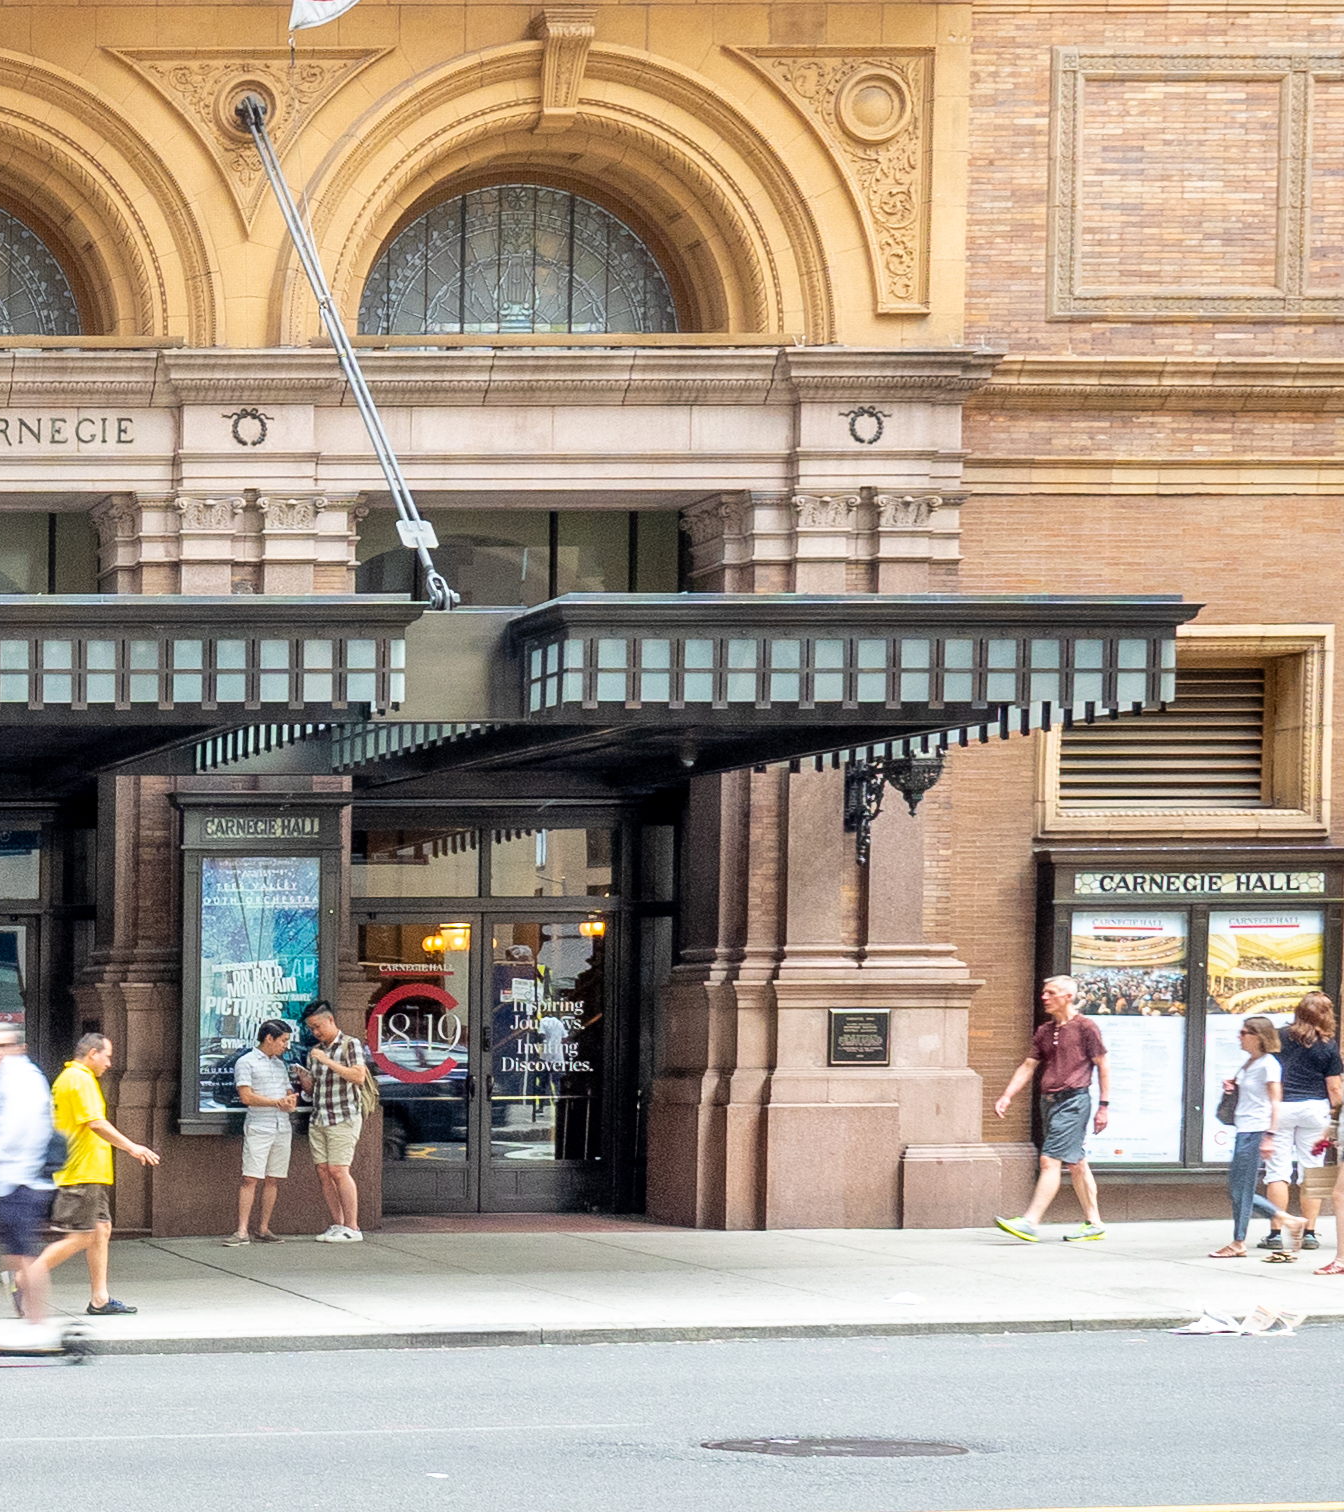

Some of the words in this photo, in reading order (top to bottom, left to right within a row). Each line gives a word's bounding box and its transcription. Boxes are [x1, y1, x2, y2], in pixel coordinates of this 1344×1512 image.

[204, 817, 279, 836] CARNEGIE
[282, 817, 320, 836] HALL
[1099, 875, 1222, 892] CARNEGIE
[1236, 875, 1301, 892] HALL
[245, 895, 318, 904] ORCHESTRA
[1092, 918, 1139, 926] CARNEGIE
[1140, 918, 1164, 927] HALL
[1228, 917, 1275, 925] CARNEGIE
[1276, 917, 1301, 925] HALL
[232, 970, 250, 984] ON
[252, 965, 283, 982] BALD
[379, 963, 427, 972] CARNEGIE
[428, 963, 454, 972] HALL
[227, 976, 297, 998] MOUNTAIN
[204, 995, 283, 1019] PICTURES
[512, 999, 585, 1015] Inspiring
[516, 1039, 579, 1056] Inviting
[501, 1057, 594, 1073] Discoveries.
